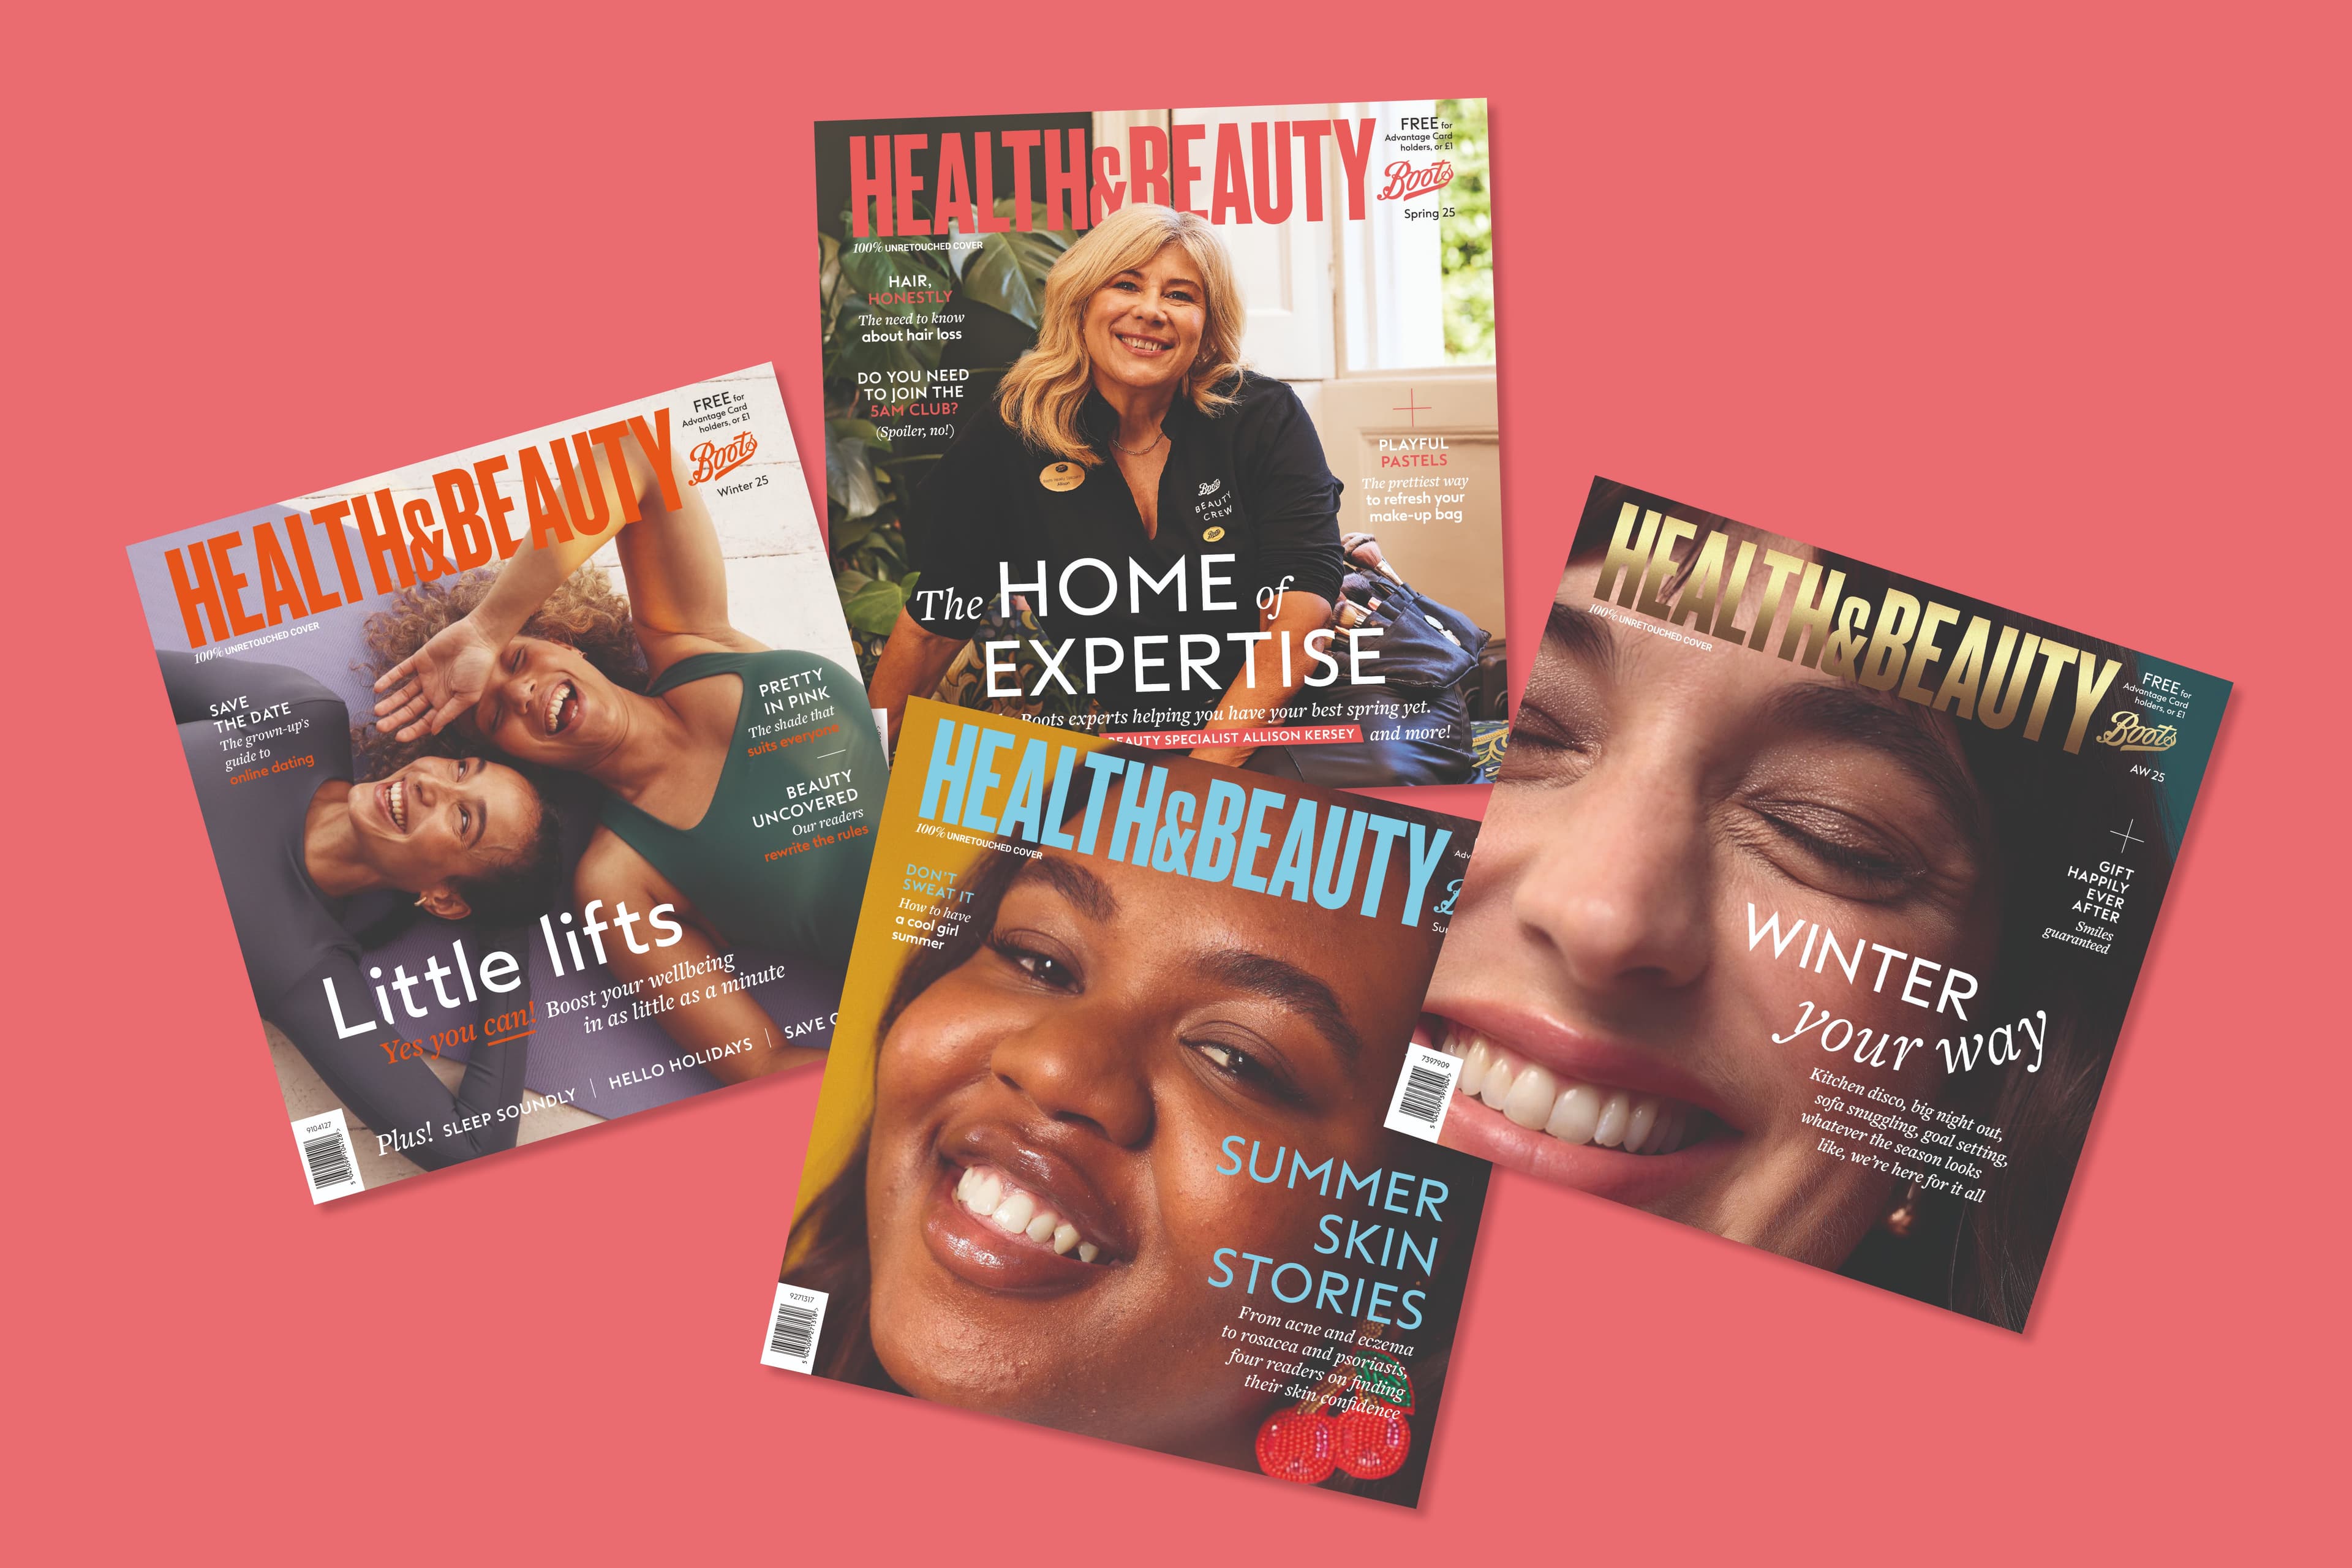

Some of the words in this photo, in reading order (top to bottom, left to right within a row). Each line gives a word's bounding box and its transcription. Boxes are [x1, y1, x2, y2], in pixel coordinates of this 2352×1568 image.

[1401, 117, 1438, 130] FREE
[1385, 134, 1430, 142] Advantage
[850, 118, 1376, 237] HEALTH&BEAUTY
[1377, 159, 1454, 201] Boots
[1404, 209, 1439, 221] Spring
[1442, 208, 1455, 217] 25
[853, 242, 883, 253] 100%
[885, 243, 951, 252] UNRETOUCHED
[954, 241, 983, 250] COVER
[889, 274, 932, 288] HAIR,
[869, 290, 953, 305] HONESTLY
[859, 314, 882, 326] The
[885, 312, 913, 325] need
[916, 314, 928, 324] to
[932, 312, 965, 323] know
[862, 330, 903, 342] about
[907, 328, 933, 341] hair
[937, 328, 962, 340] loss
[858, 371, 881, 384] DO
[887, 370, 921, 383] YOU
[927, 369, 969, 382] NEED
[864, 388, 886, 401] TO
[891, 386, 927, 403] JOIN
[932, 385, 963, 398] THE
[871, 404, 904, 417] 5AM
[910, 402, 959, 415] CLUB?
[876, 426, 927, 441] (Spoiler,
[930, 424, 954, 439] no!)
[1379, 437, 1449, 451] PLAYFUL
[688, 431, 758, 486] Boots
[1381, 454, 1447, 467] PASTELS
[717, 481, 753, 497] Winter
[755, 475, 769, 487] 25
[1198, 478, 1221, 496] Boots
[1362, 478, 1385, 489] The
[1387, 475, 1441, 492] prettiest
[1444, 477, 1469, 489] way
[1195, 491, 1232, 513] BEAUTY
[1366, 494, 1381, 505] to
[1384, 491, 1431, 505] refresh
[1434, 492, 1465, 507] your
[1203, 505, 1232, 521] CREW
[1370, 509, 1431, 524] make-up
[1436, 508, 1463, 523] bag
[164, 408, 682, 649] HEALTH&BEAUTY
[916, 587, 983, 621] The
[1000, 553, 1237, 618] HOME
[1256, 575, 1294, 620] of
[1593, 502, 2122, 755] HEALTH&BEAUTY
[986, 627, 1385, 698] EXPERTISE
[759, 668, 823, 697] PRETTY
[209, 696, 249, 717] SAVE
[764, 701, 784, 715] IN
[788, 686, 831, 709] PINK
[213, 715, 247, 733] THE
[251, 702, 292, 724] DATE
[748, 725, 771, 739] The
[774, 714, 808, 731] shade
[810, 705, 835, 722] that
[1069, 710, 1128, 729] experts
[1133, 707, 1191, 728] helping
[1194, 710, 1224, 726] you
[1228, 706, 1265, 720] have
[1268, 707, 1307, 723] your
[1311, 702, 1344, 717] best
[1347, 700, 1400, 720] spring
[1401, 700, 1431, 716] yet.
[220, 737, 243, 751] The
[747, 741, 778, 757] suits
[780, 723, 840, 748] everyone
[1165, 733, 1238, 745] SPECIALIST
[1243, 729, 1302, 742] ALLISON
[1305, 728, 1355, 741] KERSEY
[1370, 726, 1401, 741] and
[1405, 725, 1451, 740] more!
[2096, 710, 2177, 752] Boots
[230, 766, 270, 785] online
[272, 755, 314, 774] dating
[2130, 764, 2151, 777] AW
[2151, 771, 2165, 782] 25
[786, 769, 852, 799] BEAUTY
[752, 788, 858, 828] UNCOVERED
[793, 821, 816, 836] Our
[819, 809, 864, 829] readers
[919, 718, 1452, 927] HEALTH&BEAUTY
[764, 841, 810, 862] rewrite
[812, 834, 835, 848] the
[837, 825, 869, 841] rules
[914, 823, 946, 838] 100%
[947, 832, 1012, 853] UNRETOUCHED
[1013, 846, 1043, 860] COVER
[2067, 865, 2130, 894] HAPPILY
[2099, 861, 2135, 880] GIFT
[903, 879, 956, 899] SWEAT
[959, 891, 974, 903] IT
[2086, 888, 2125, 910] EVER
[898, 898, 928, 912] How
[929, 905, 941, 916] to
[943, 907, 971, 922] have
[2071, 900, 2120, 924] AFTER
[892, 931, 944, 949] summer
[2041, 927, 2111, 954] guaranteed
[2076, 921, 2114, 941] Smiles
[323, 939, 521, 1039] Little
[540, 899, 683, 977] lifts
[1747, 902, 1978, 1022] WINTER
[545, 993, 597, 1019] Boost
[600, 979, 644, 1008] your
[648, 952, 736, 989] wellbeing
[379, 1038, 423, 1065] Yes
[429, 1023, 477, 1060] you
[484, 1000, 537, 1038] can!
[1771, 1000, 1924, 1071] your
[1935, 1010, 2047, 1074] way
[1421, 1055, 1450, 1069] 7397909
[376, 1121, 433, 1156] Plus!
[443, 1115, 491, 1137] SLEEP
[497, 1088, 576, 1123] SOUNDLY
[608, 1063, 665, 1090] HELLO
[669, 1037, 753, 1072] HOLIDAYS
[784, 1016, 826, 1039] SAVE
[1809, 1067, 1865, 1096] Kitchen
[1868, 1086, 1907, 1112] disco,
[1911, 1099, 1935, 1121] big
[1936, 1108, 1975, 1131] night
[1976, 1124, 2003, 1142] out,
[306, 1121, 331, 1133] 9104127
[1814, 1094, 1844, 1112] sofa
[1846, 1104, 1919, 1140] snuggling,
[1920, 1129, 1956, 1148] goal
[1956, 1139, 2009, 1168] setting,
[1216, 1136, 1449, 1222] SUMMER
[1313, 1214, 1438, 1277] SKIN
[790, 1292, 815, 1303] 9271317
[1207, 1247, 1427, 1330] STORIES
[1238, 1306, 1281, 1327] From
[1285, 1320, 1322, 1336] acne
[1324, 1328, 1356, 1344] and
[1358, 1336, 1414, 1357] eczema
[1244, 1374, 1283, 1393] their
[1284, 1384, 1317, 1402] skin
[1321, 1393, 1401, 1420] confidence
